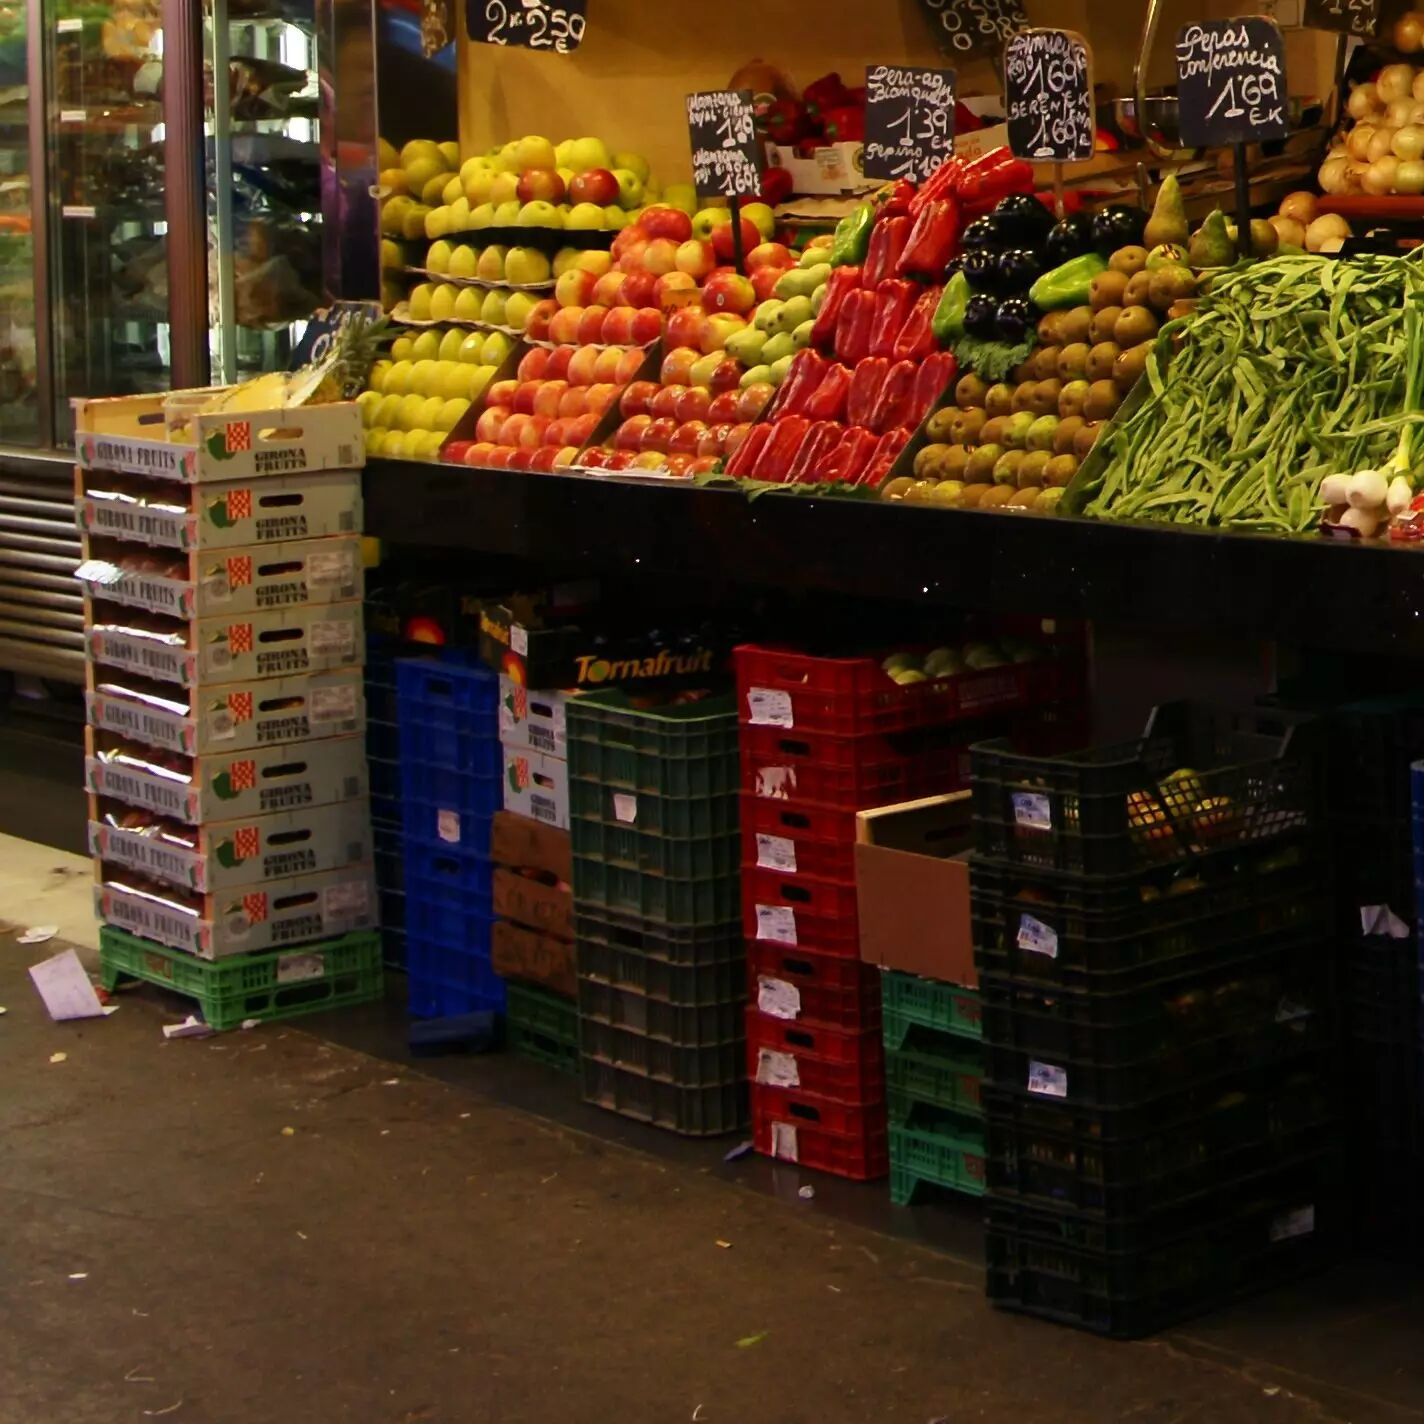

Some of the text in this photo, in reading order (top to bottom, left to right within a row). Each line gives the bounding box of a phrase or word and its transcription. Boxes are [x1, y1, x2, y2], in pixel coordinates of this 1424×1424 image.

[255, 448, 305, 460] GIRONA
[255, 459, 307, 472] FRUITS
[256, 516, 307, 528] GIRONA
[256, 527, 307, 540] FRUITS
[256, 584, 307, 597] GIRONA
[256, 594, 309, 607] FRUITS
[257, 648, 308, 661] GIRONA
[257, 659, 310, 674] FRUITS
[575, 646, 716, 684] Tornafruit
[257, 716, 308, 730] GIRONA
[257, 727, 310, 742] FRUITS
[260, 784, 312, 798] GIRONA
[260, 795, 312, 810] FRUITS
[264, 849, 315, 864] GIRONA
[264, 861, 316, 876] FRUITS
[272, 914, 322, 929] GIRONA
[272, 925, 323, 941] FRUITS
